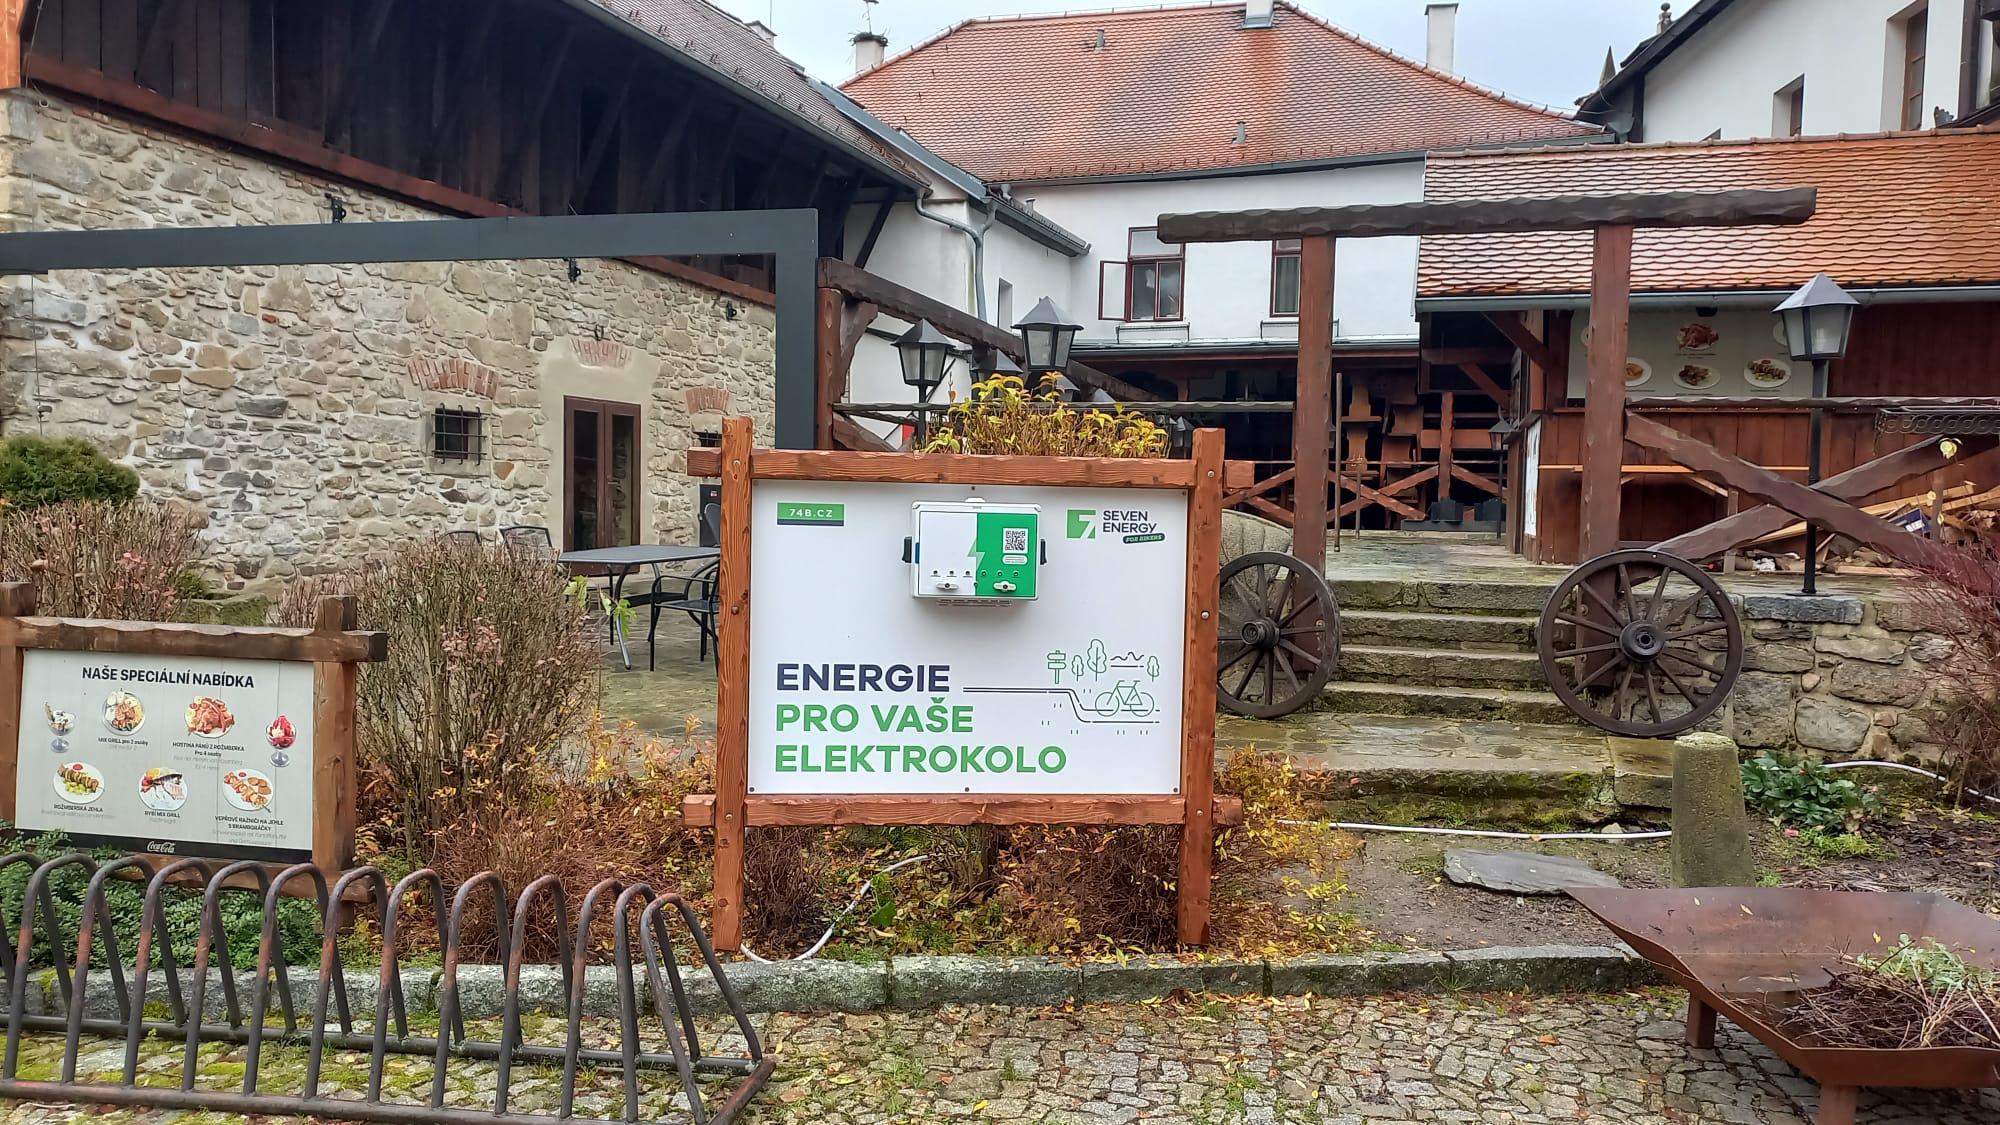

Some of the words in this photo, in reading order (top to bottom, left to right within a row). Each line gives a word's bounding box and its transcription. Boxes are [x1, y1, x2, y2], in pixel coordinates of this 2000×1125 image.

[789, 508, 833, 518] 74B.CZ
[1103, 522, 1157, 533] ENERGY
[1139, 534, 1163, 542] BIKERS
[82, 665, 118, 681] NAŠE
[120, 668, 190, 685] SPECIÁLNÍ
[192, 672, 255, 689] NABÍDKA
[776, 663, 951, 693] ENERGIE
[775, 704, 860, 733] PRO
[871, 697, 974, 733] VAŠE
[775, 744, 1067, 774] ELEKTROKOLO
